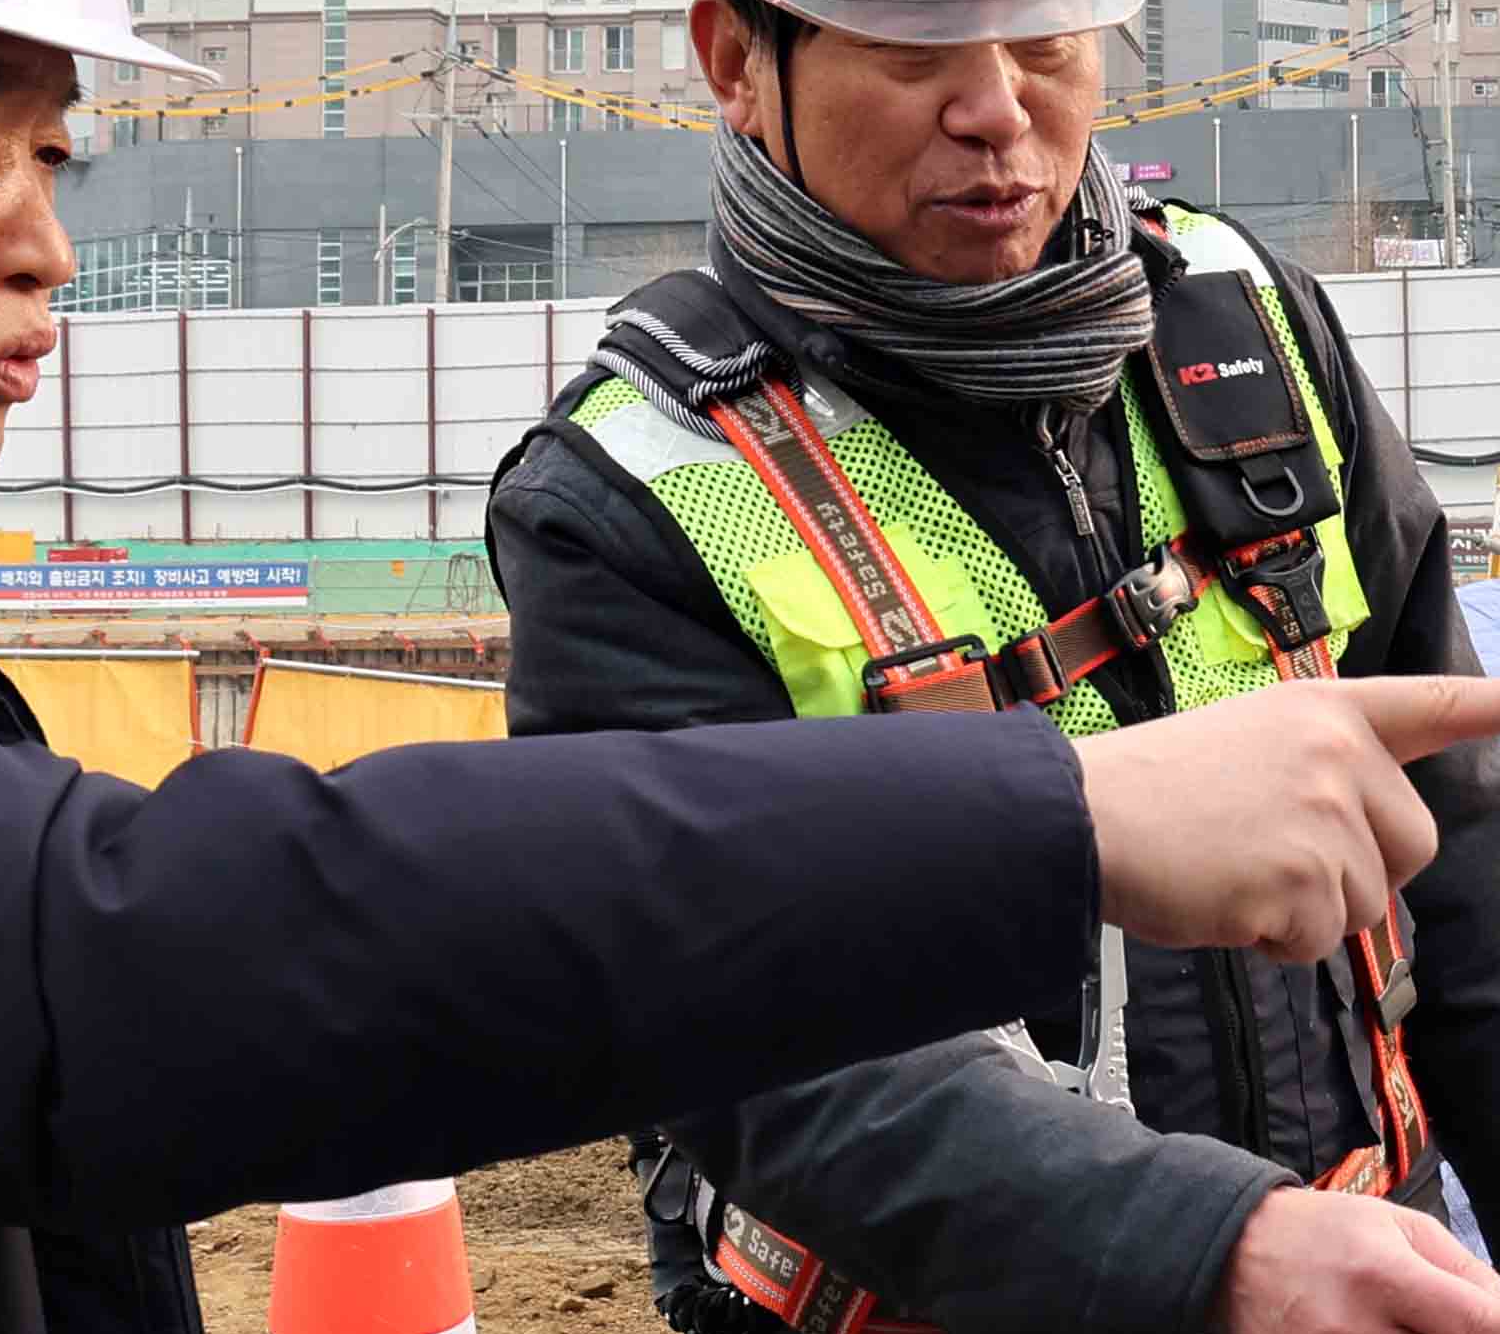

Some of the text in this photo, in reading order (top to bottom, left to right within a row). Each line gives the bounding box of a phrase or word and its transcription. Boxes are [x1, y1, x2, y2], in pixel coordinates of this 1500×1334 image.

[1178, 358, 1264, 386] K2 Safety
[816, 500, 889, 600] Safety
[153, 568, 210, 586] 장비사고
